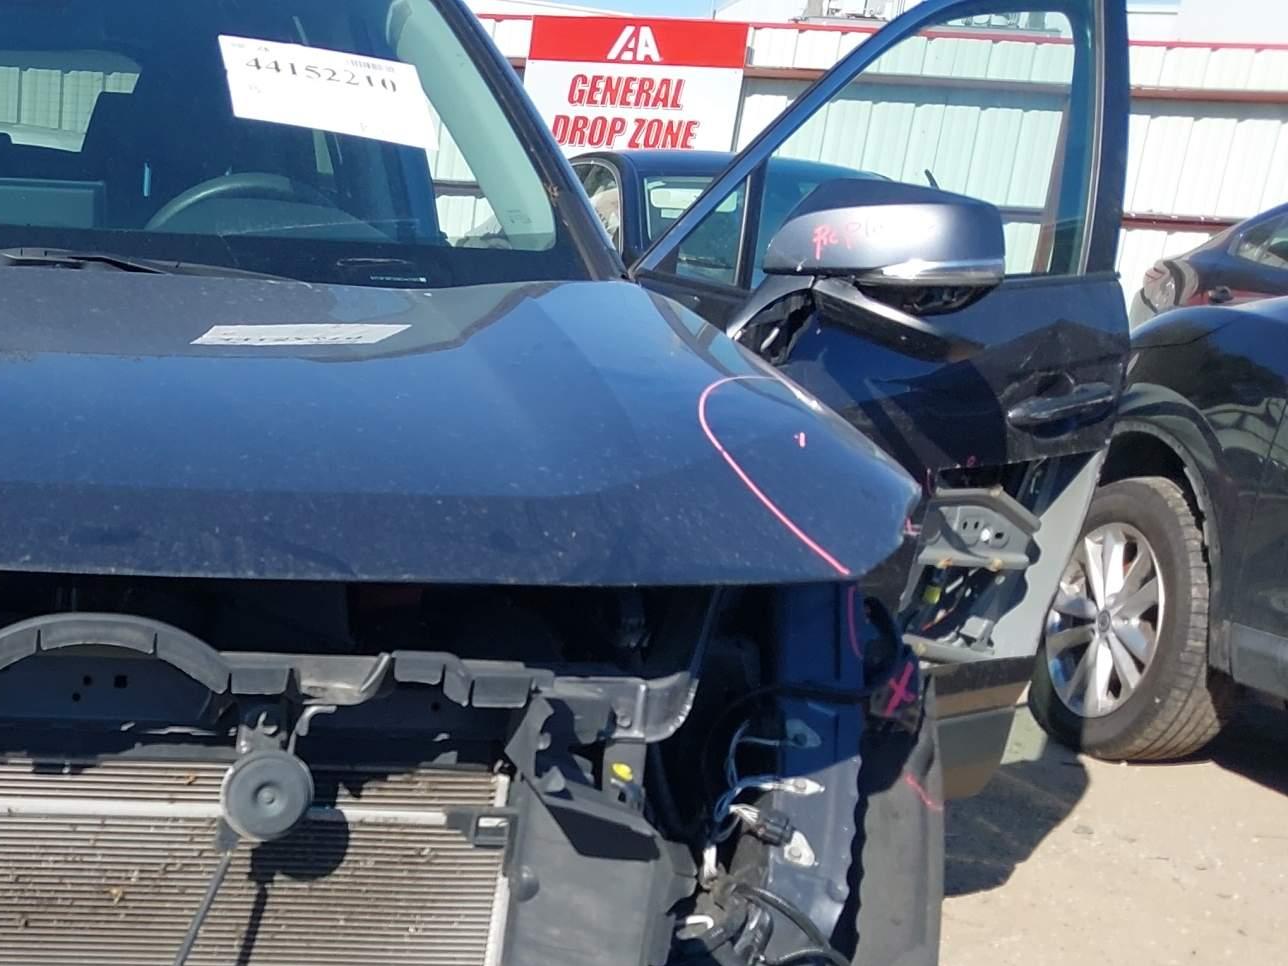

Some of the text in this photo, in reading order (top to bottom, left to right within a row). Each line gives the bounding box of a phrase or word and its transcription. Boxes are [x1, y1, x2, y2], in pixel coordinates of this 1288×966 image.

[245, 57, 398, 93] 44152210
[567, 74, 684, 110] GENERAL
[552, 115, 700, 150] DROP ZONE
